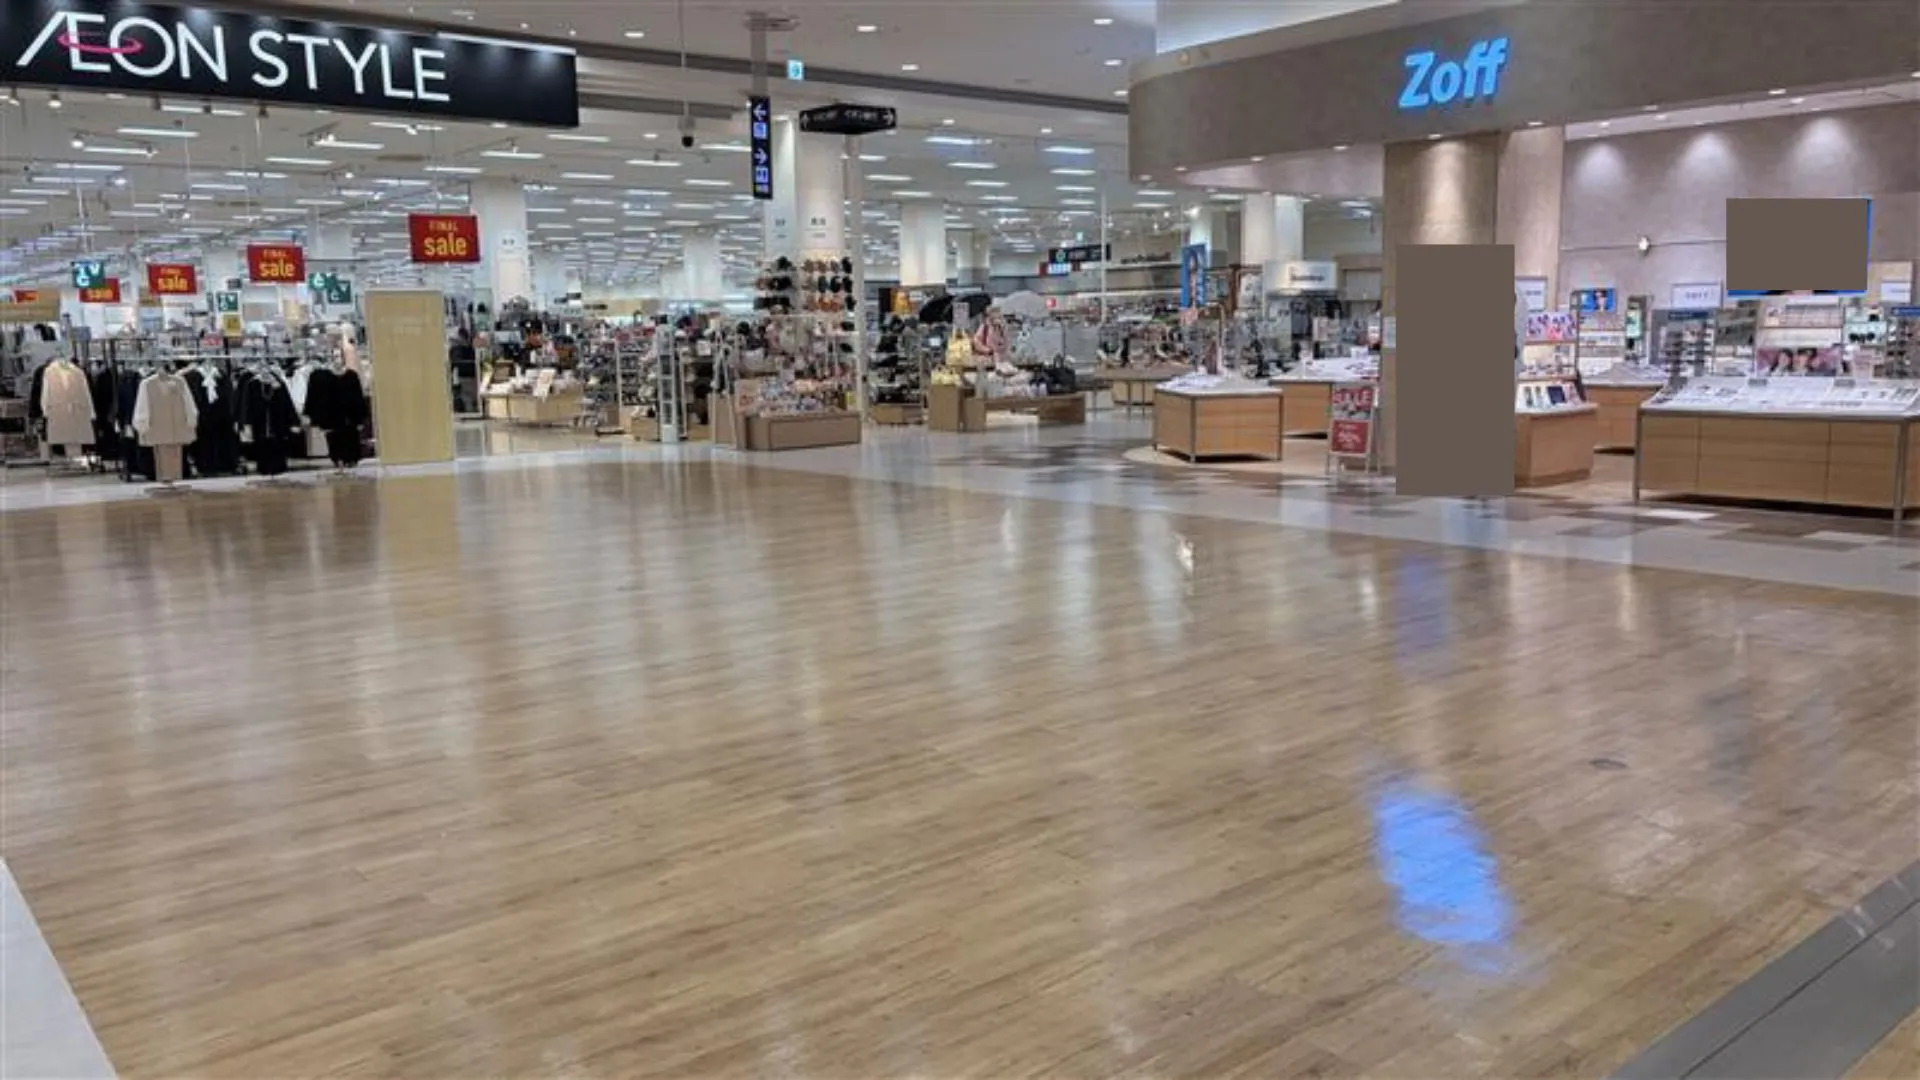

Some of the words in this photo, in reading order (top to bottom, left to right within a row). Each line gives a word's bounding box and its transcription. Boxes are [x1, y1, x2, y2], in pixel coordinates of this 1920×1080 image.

[250, 30, 451, 102] STYLE
[1399, 37, 1508, 107] Zoff
[423, 231, 467, 256] sale
[259, 258, 296, 277] sale
